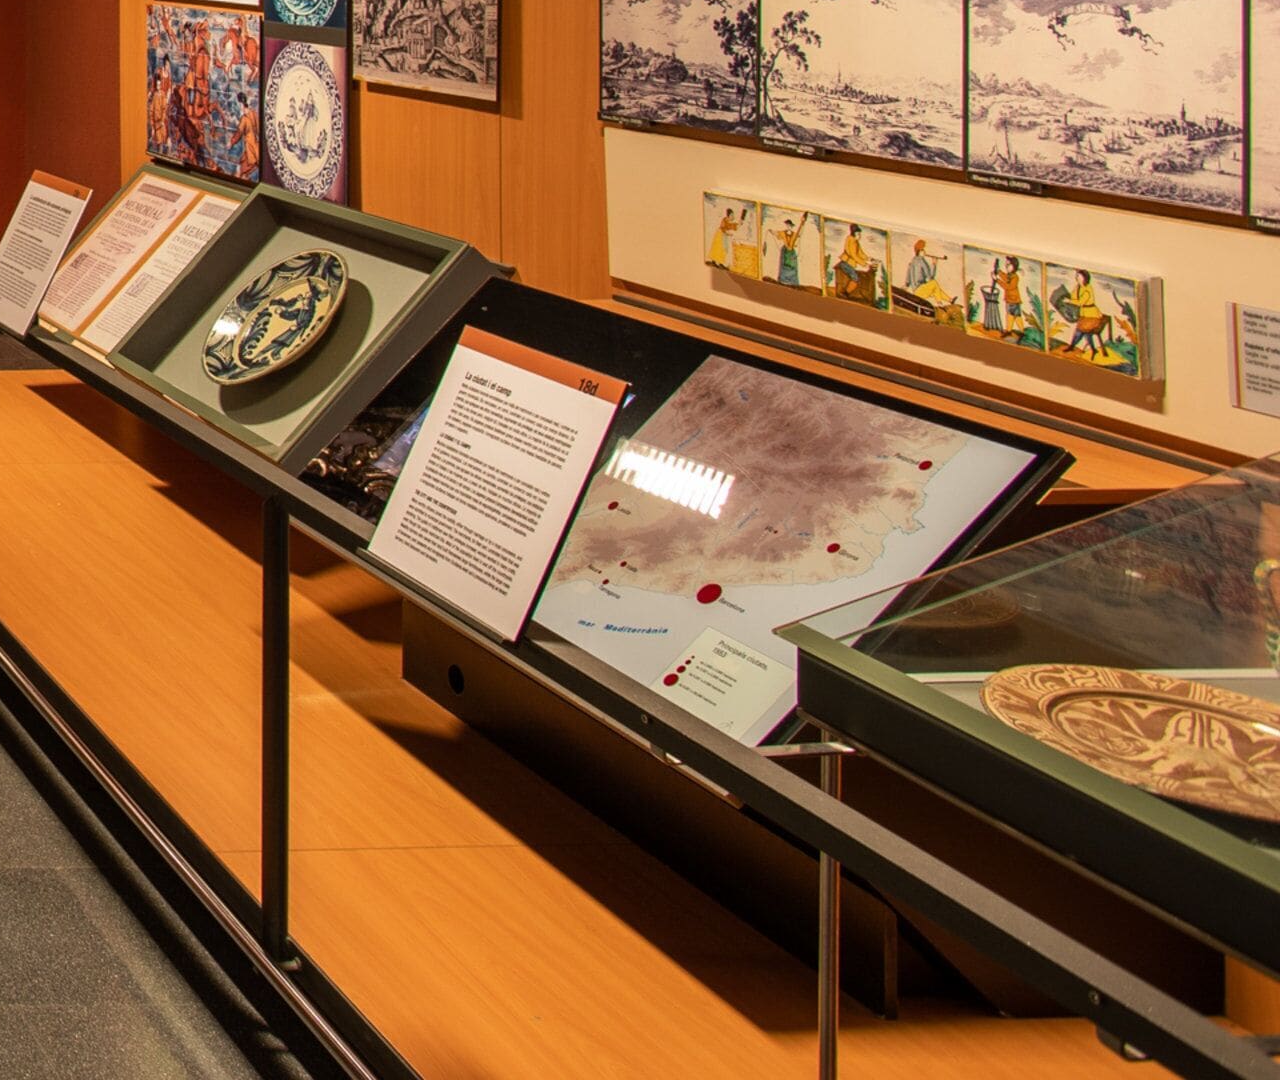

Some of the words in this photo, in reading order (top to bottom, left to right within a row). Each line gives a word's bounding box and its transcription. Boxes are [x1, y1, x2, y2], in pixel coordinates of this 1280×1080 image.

[464, 371, 473, 381] La
[472, 375, 489, 387] ciutat
[495, 385, 512, 397] camp
[578, 377, 600, 396] 18d
[718, 597, 746, 614] Barcelona
[577, 619, 595, 628] mar
[604, 624, 669, 635] Mediterrània
[718, 639, 747, 659] Principals
